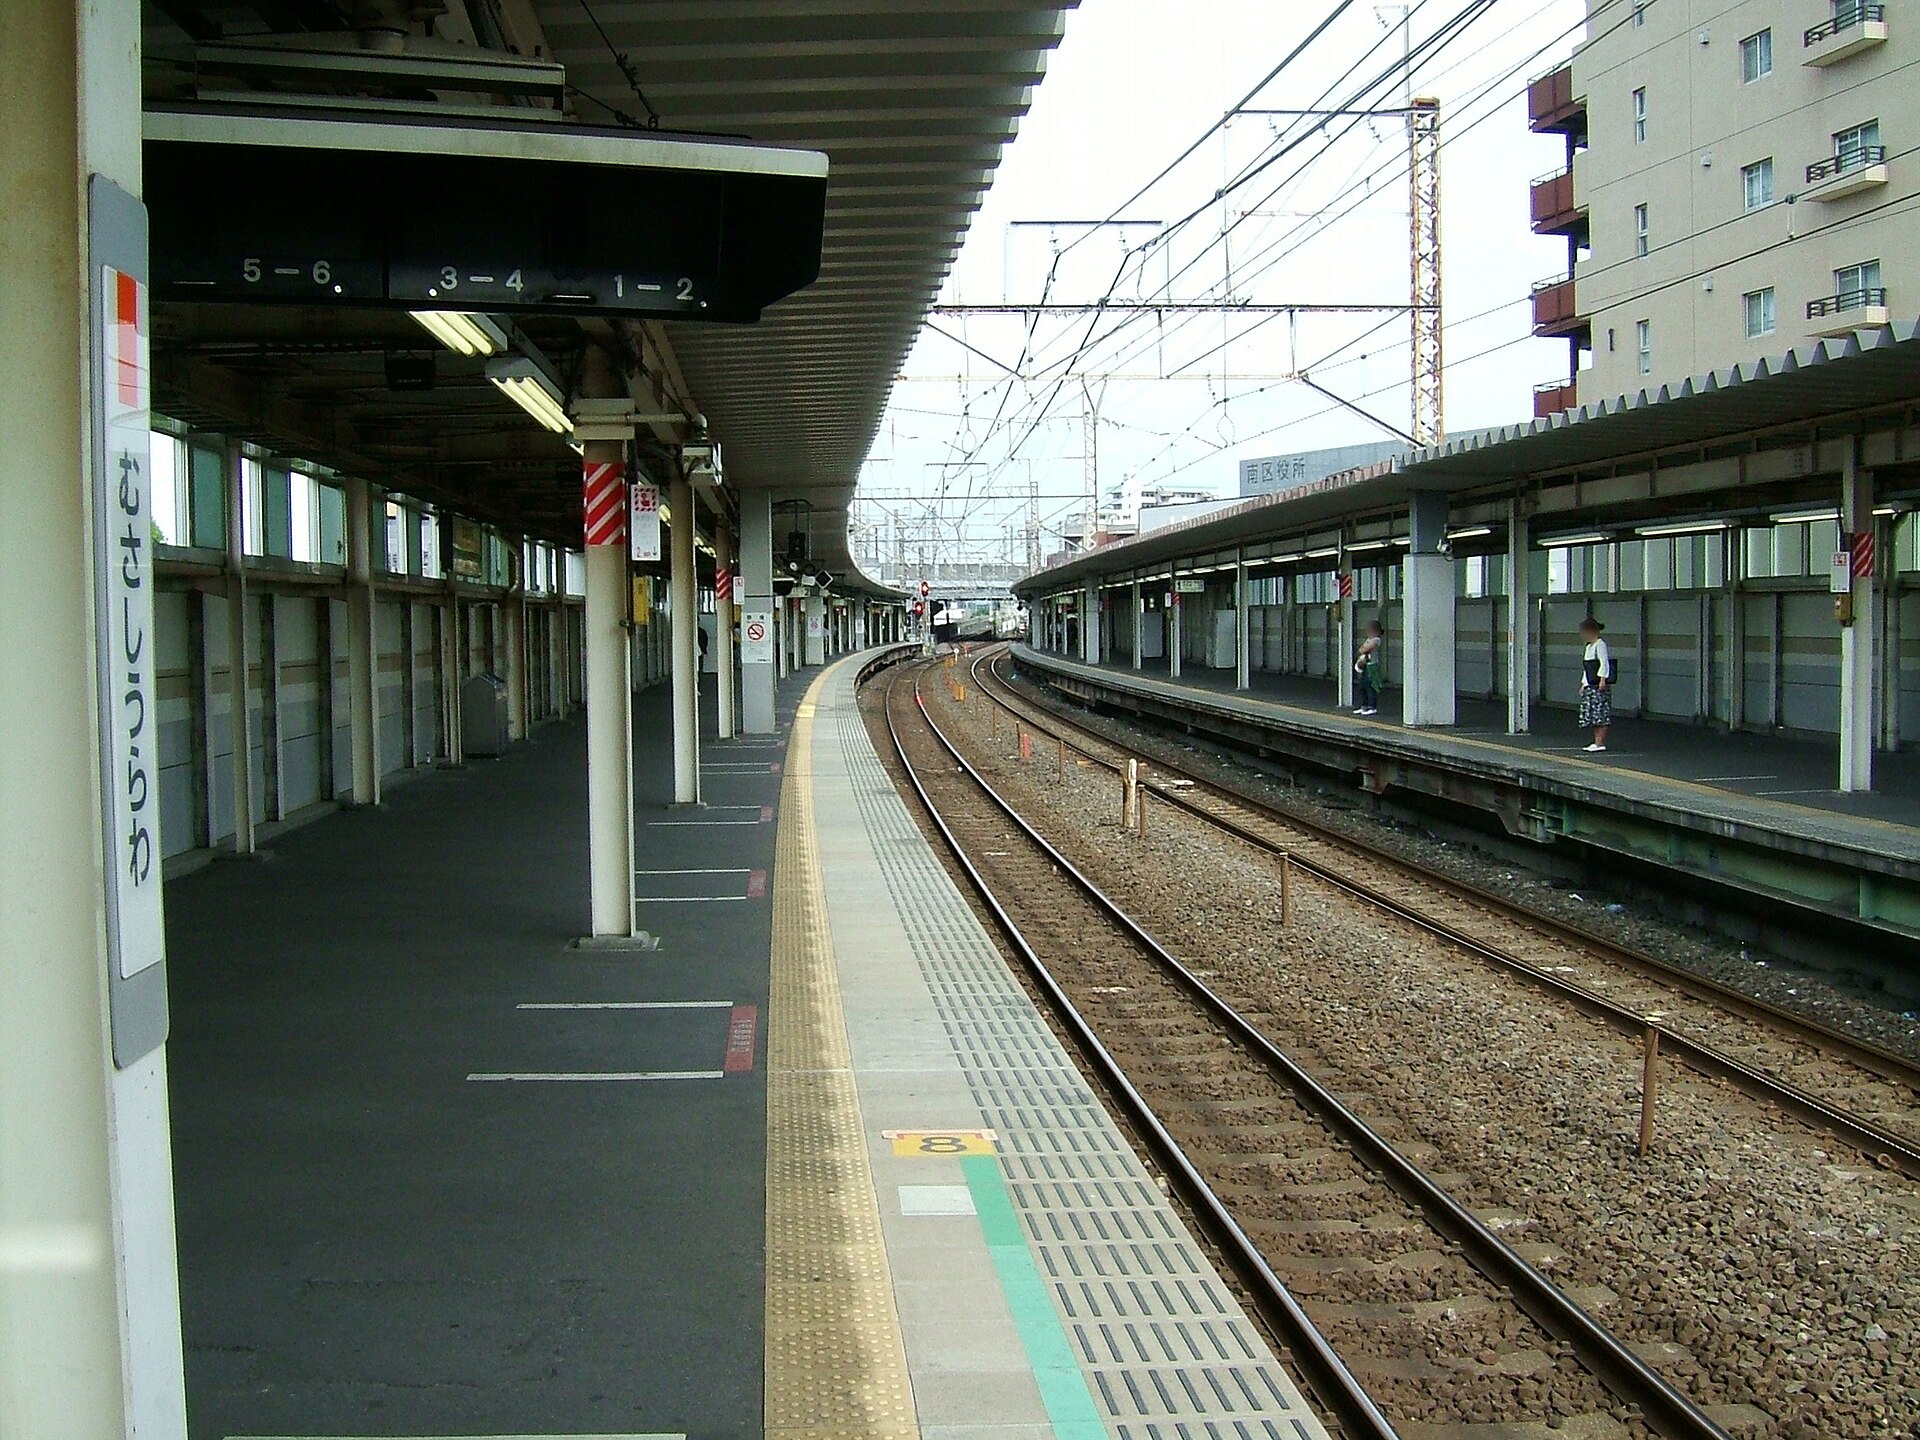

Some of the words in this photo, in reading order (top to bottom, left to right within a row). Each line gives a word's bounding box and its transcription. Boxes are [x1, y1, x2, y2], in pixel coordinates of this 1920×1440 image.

[1246, 458, 1306, 484] 南区役所
[118, 447, 151, 888] むさしうらわ
[919, 1136, 968, 1153] 8
